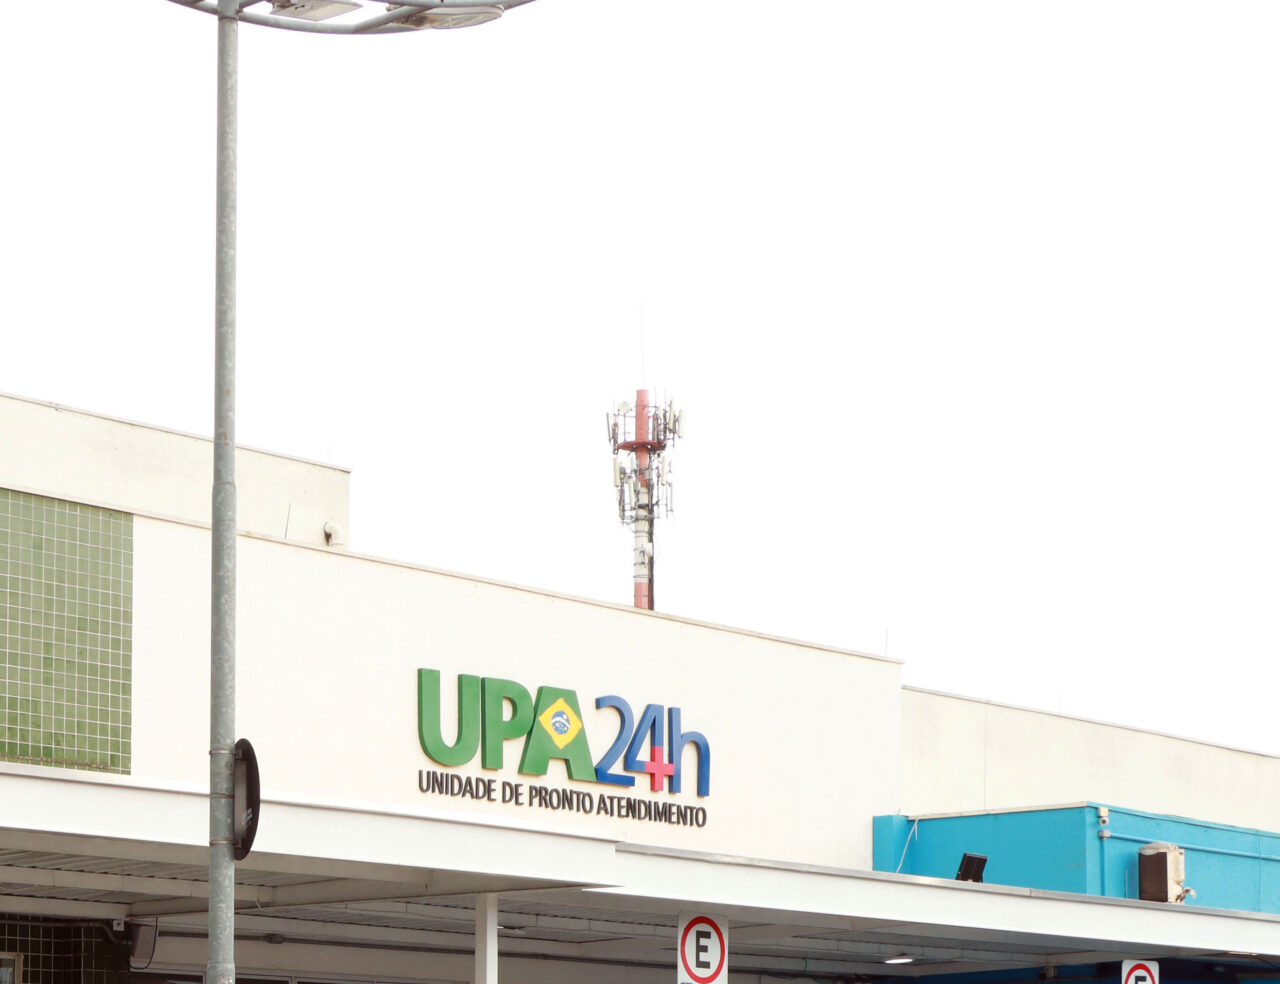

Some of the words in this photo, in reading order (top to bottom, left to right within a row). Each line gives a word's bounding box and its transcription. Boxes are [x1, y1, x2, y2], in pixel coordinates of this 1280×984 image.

[417, 668, 597, 782] UPA
[595, 695, 711, 798] 24h
[418, 769, 497, 802] UNIDADE
[502, 780, 524, 806] DE
[529, 785, 594, 815] PRONTO
[596, 794, 708, 828] ATENDIMENTO
[696, 930, 711, 969] E
